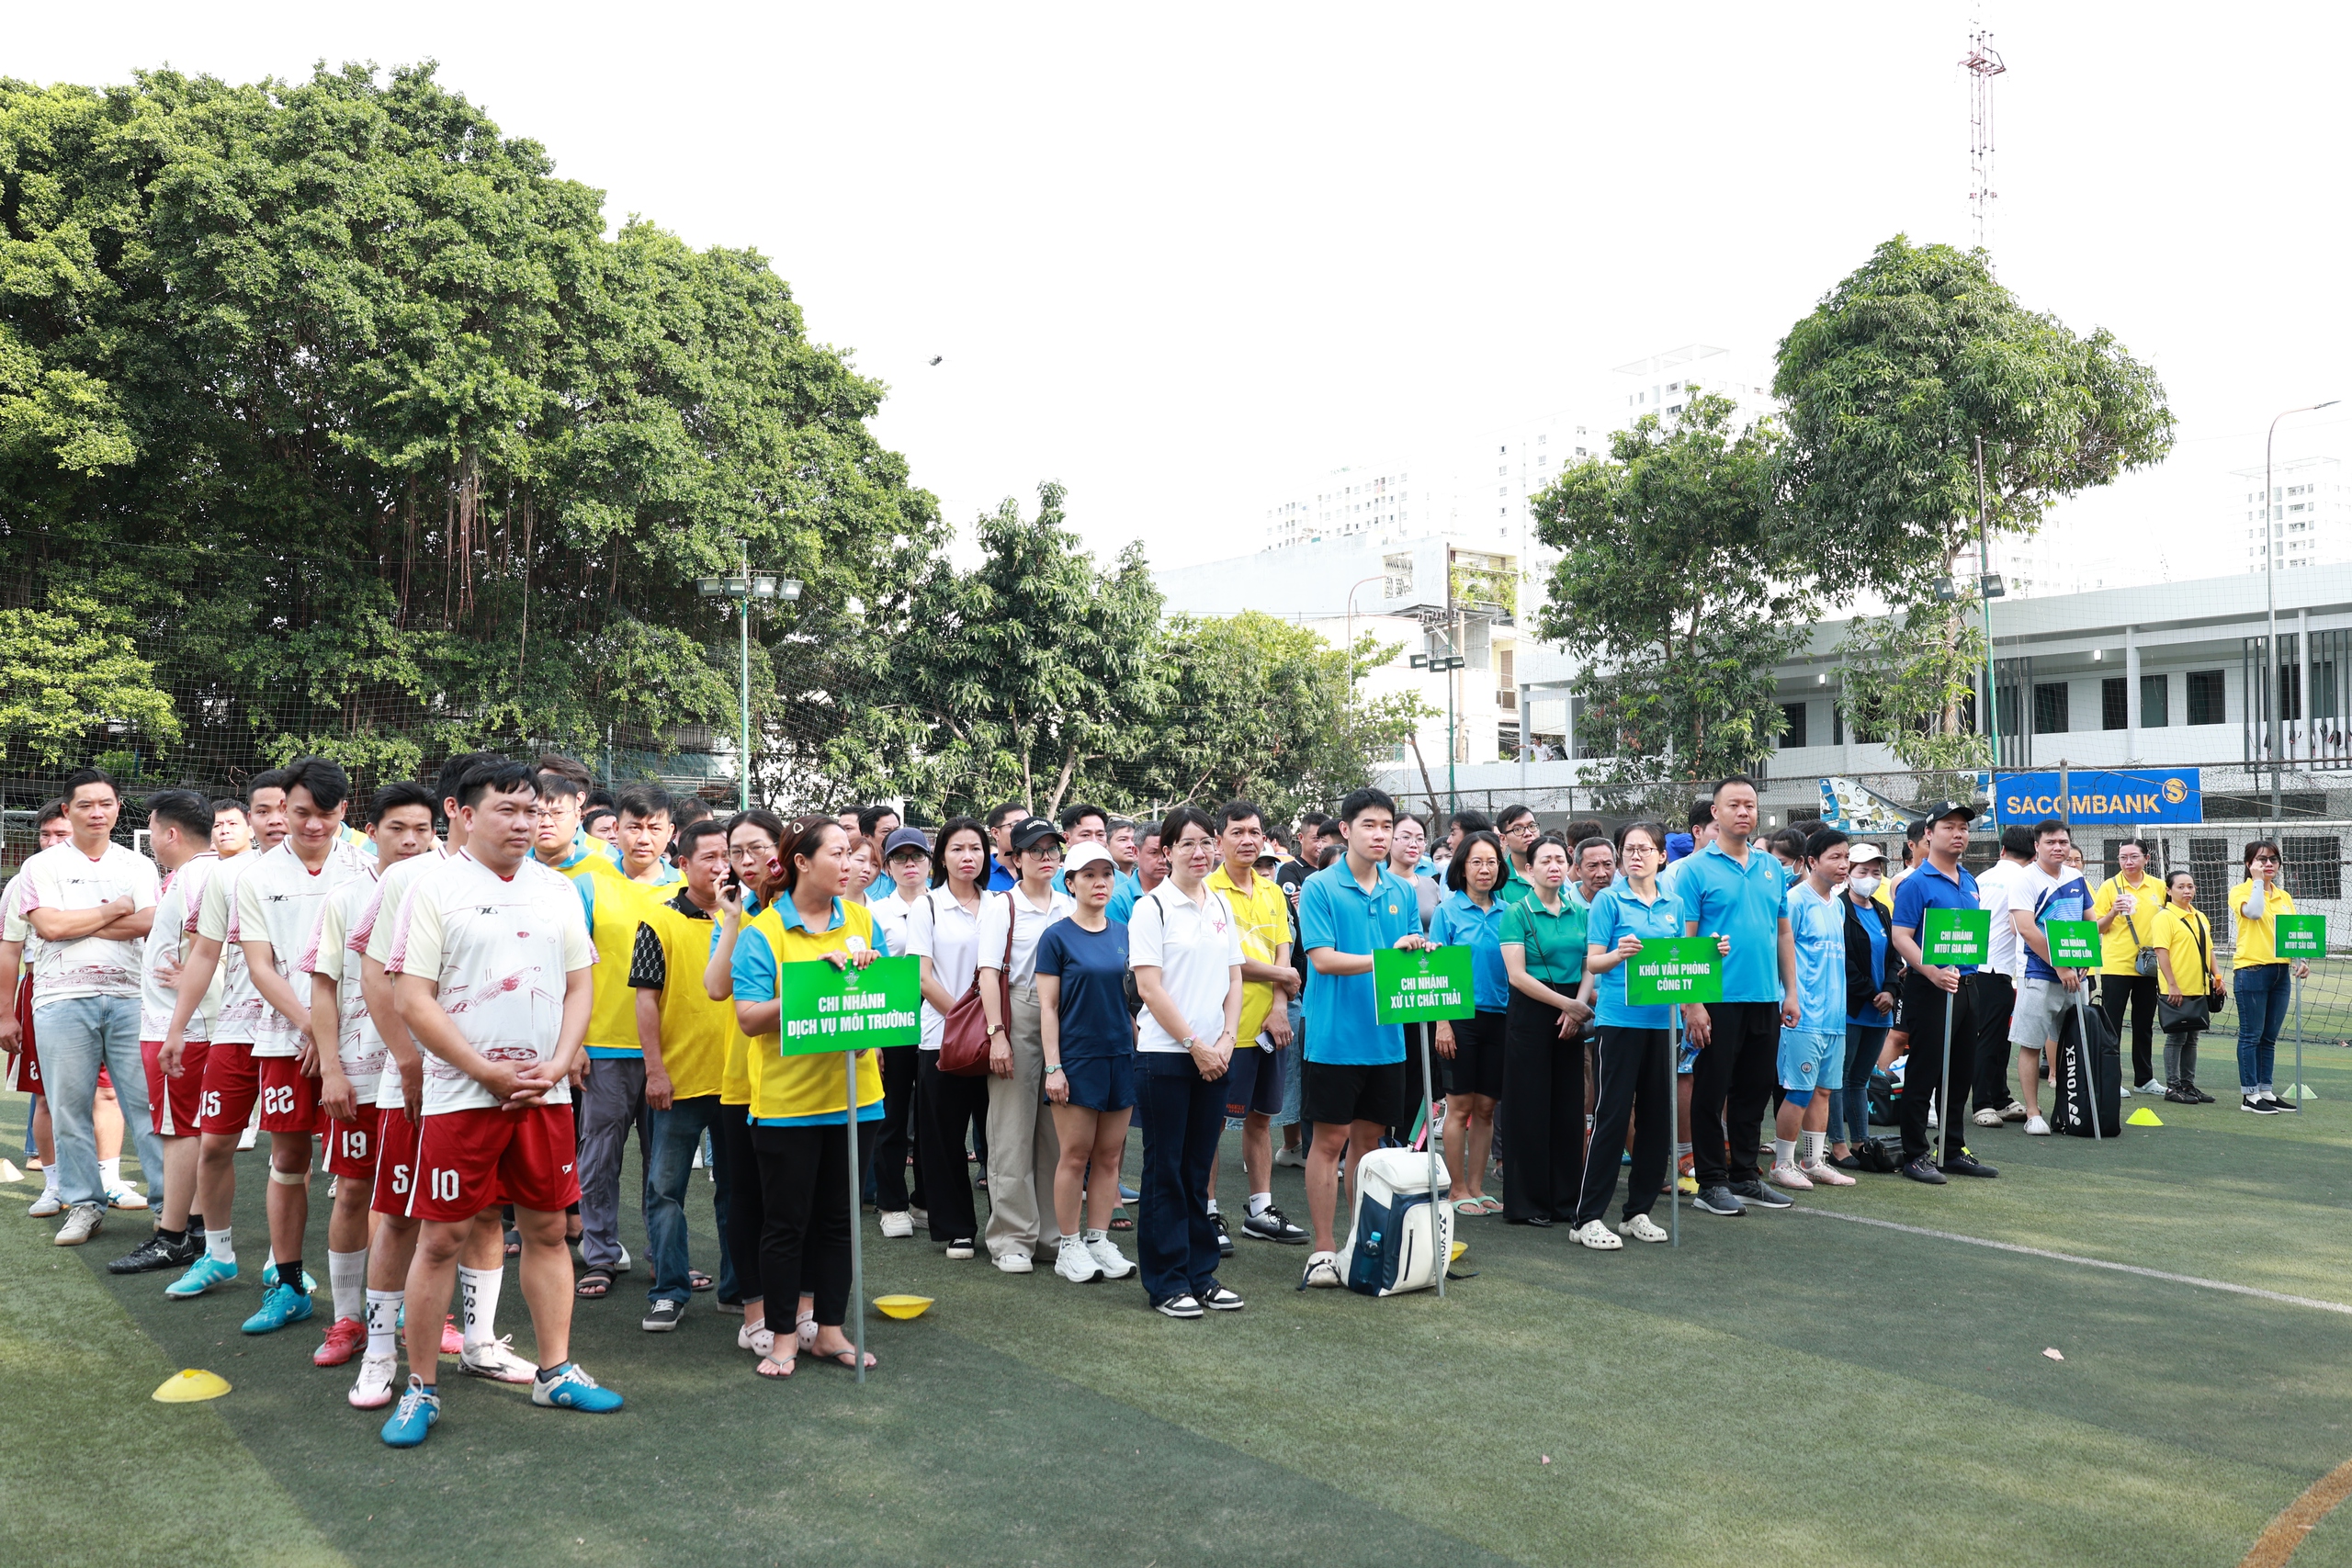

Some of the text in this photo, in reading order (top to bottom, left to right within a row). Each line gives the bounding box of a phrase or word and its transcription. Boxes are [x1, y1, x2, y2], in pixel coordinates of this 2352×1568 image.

[2007, 795, 2161, 815] SACOMBANK
[1940, 929, 1973, 941] CHI NHÁNH
[2060, 937, 2087, 947] CHI NHÁNH
[1951, 943, 1962, 953] GIA
[1638, 960, 1711, 976] KHỐI VĂN PHÒNG
[1400, 974, 1449, 991] CHI NHÁNH
[1657, 976, 1693, 991] CÔNG TY
[818, 991, 886, 1013] CHI NHÁNH
[1390, 987, 1462, 1010] XỬ LÝ CHẤT THẢI
[787, 1009, 916, 1040] DỊCH VỤ MÔI TRƯỜNG
[2065, 1044, 2077, 1101] YONEX
[200, 1089, 222, 1118] 15
[264, 1085, 295, 1115] 22
[342, 1130, 368, 1160] 19
[431, 1167, 459, 1202] 10
